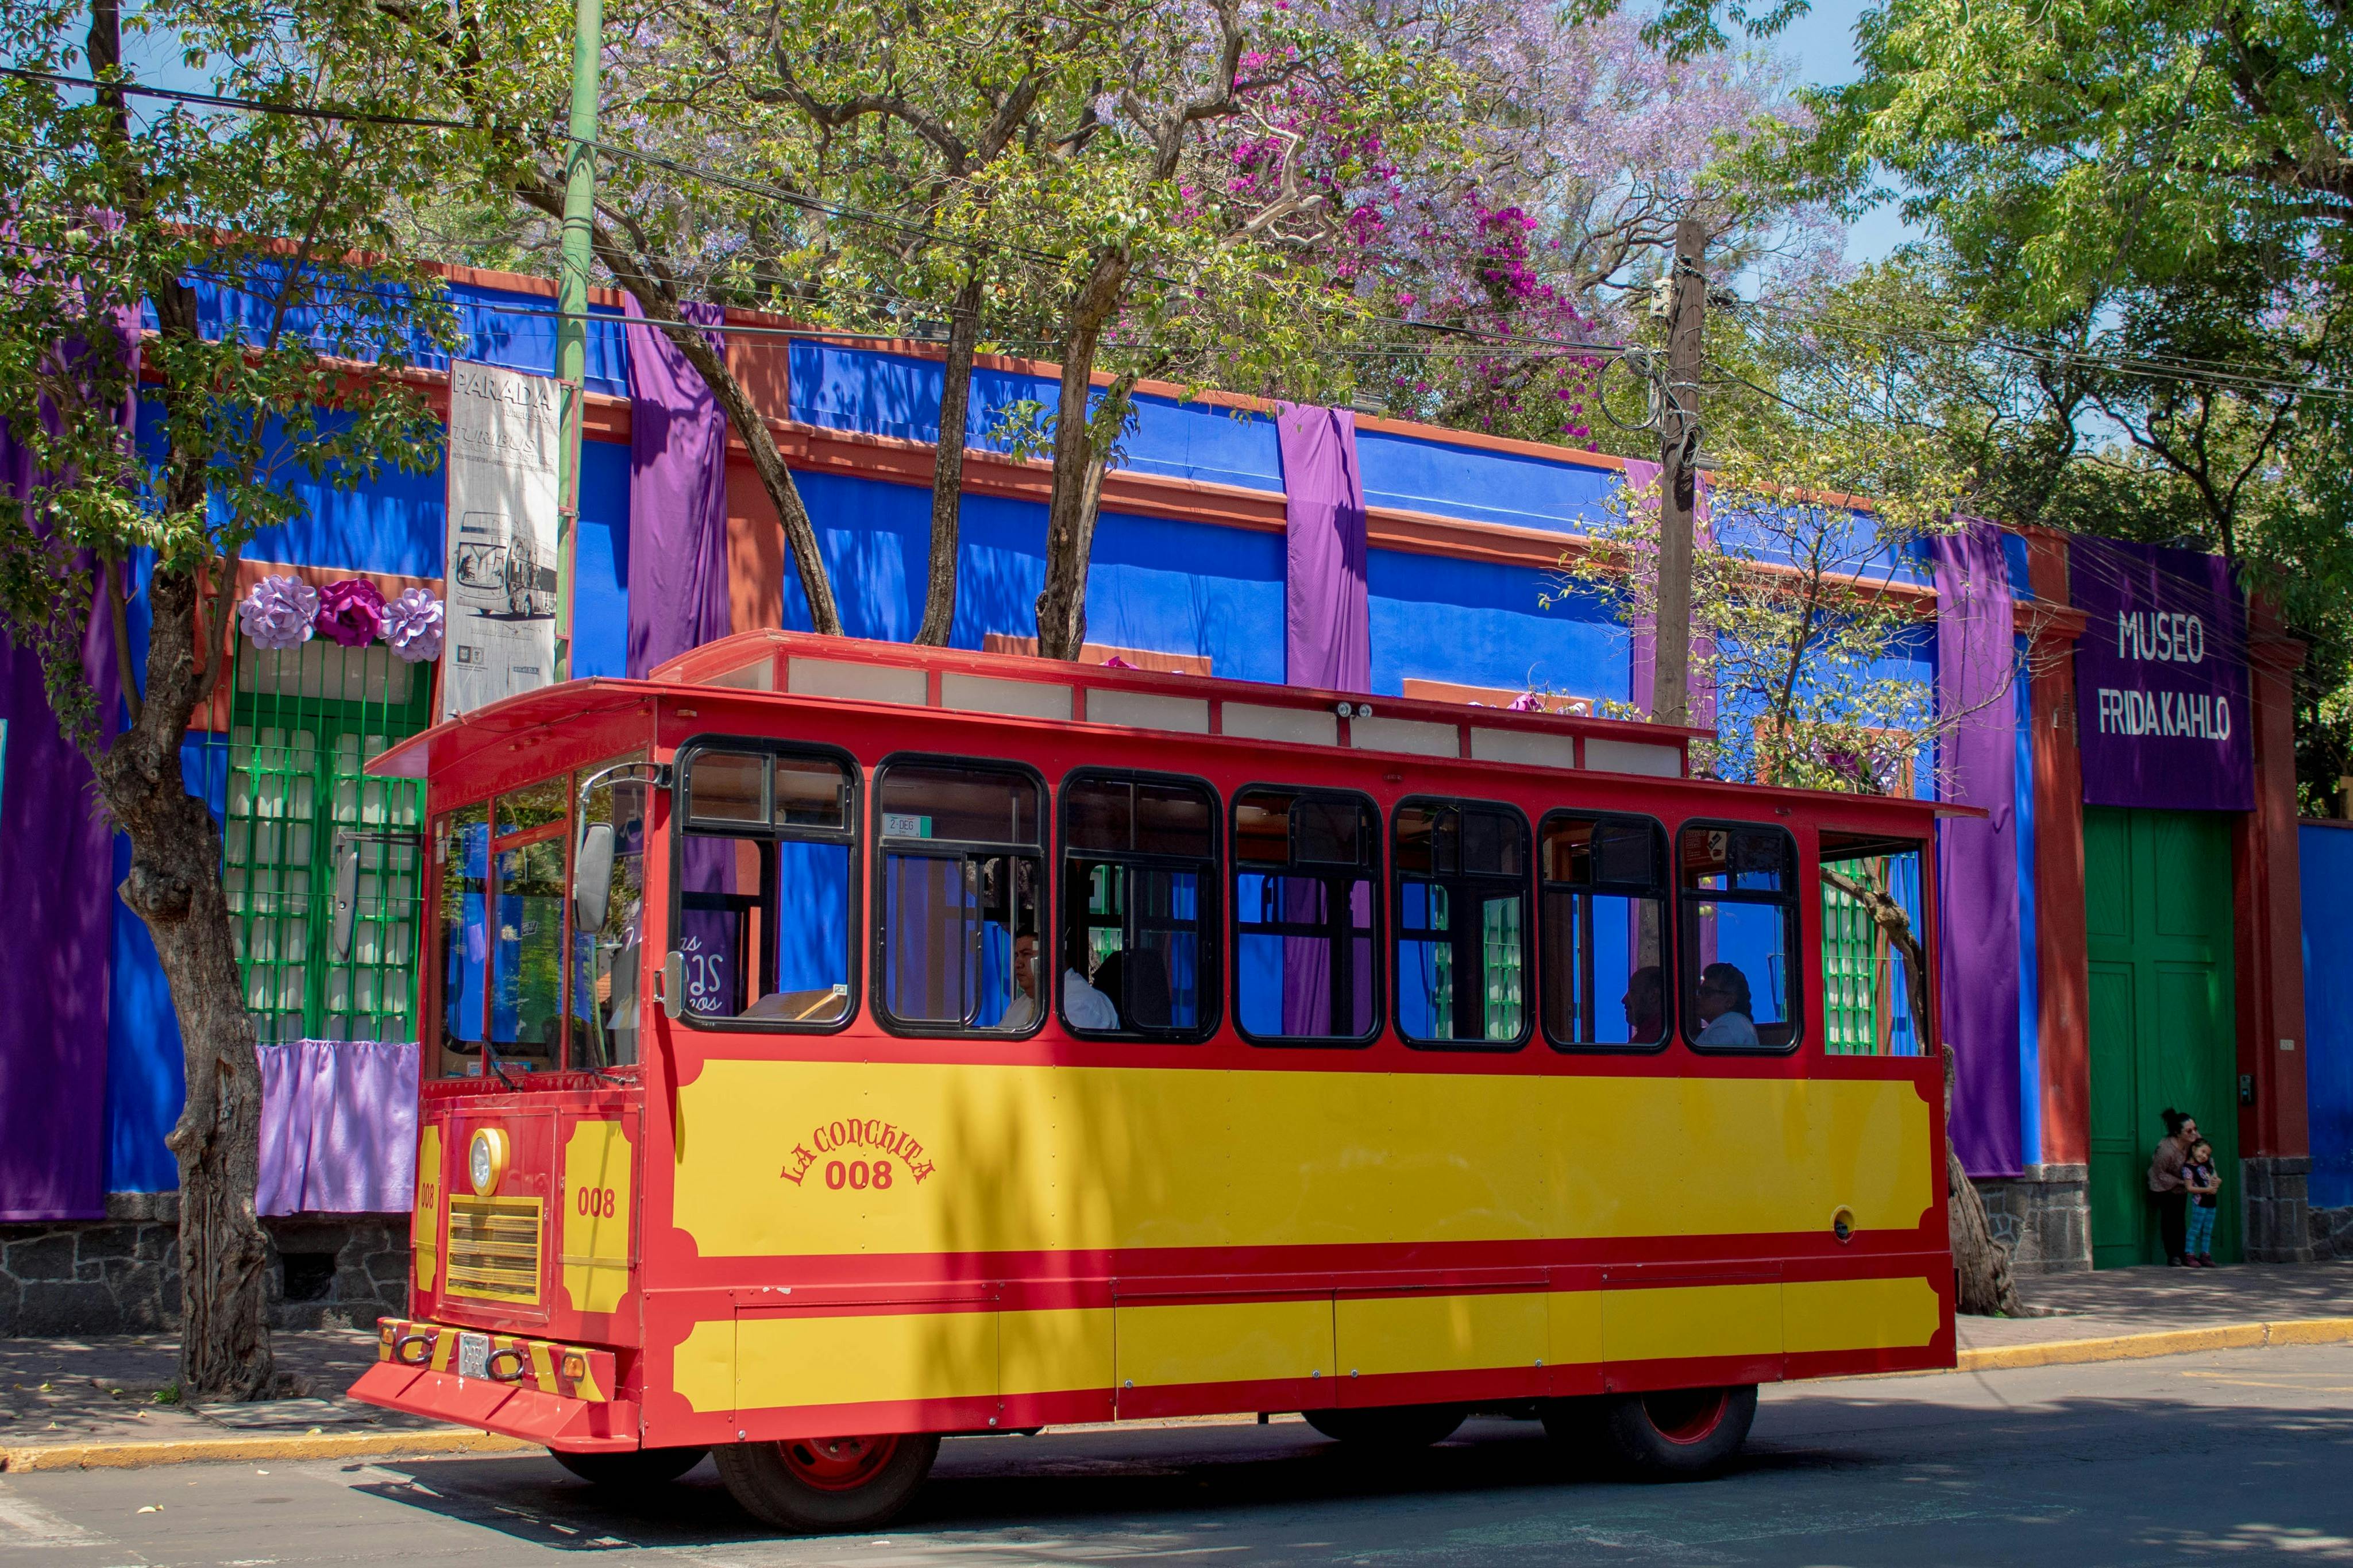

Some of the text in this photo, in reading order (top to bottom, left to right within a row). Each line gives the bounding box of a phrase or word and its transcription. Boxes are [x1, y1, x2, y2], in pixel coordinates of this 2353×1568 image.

[453, 369, 553, 411] PARADA
[503, 408, 554, 424] TURIBUS STOP
[453, 426, 535, 453] TURIBUS
[2118, 609, 2204, 664] MUSEO
[2098, 688, 2231, 741] FRIDA KAHLO
[780, 1118, 936, 1187] LA CONCHITA
[825, 1160, 893, 1190] 008
[422, 1183, 434, 1210] 008
[578, 1186, 615, 1218] 008
